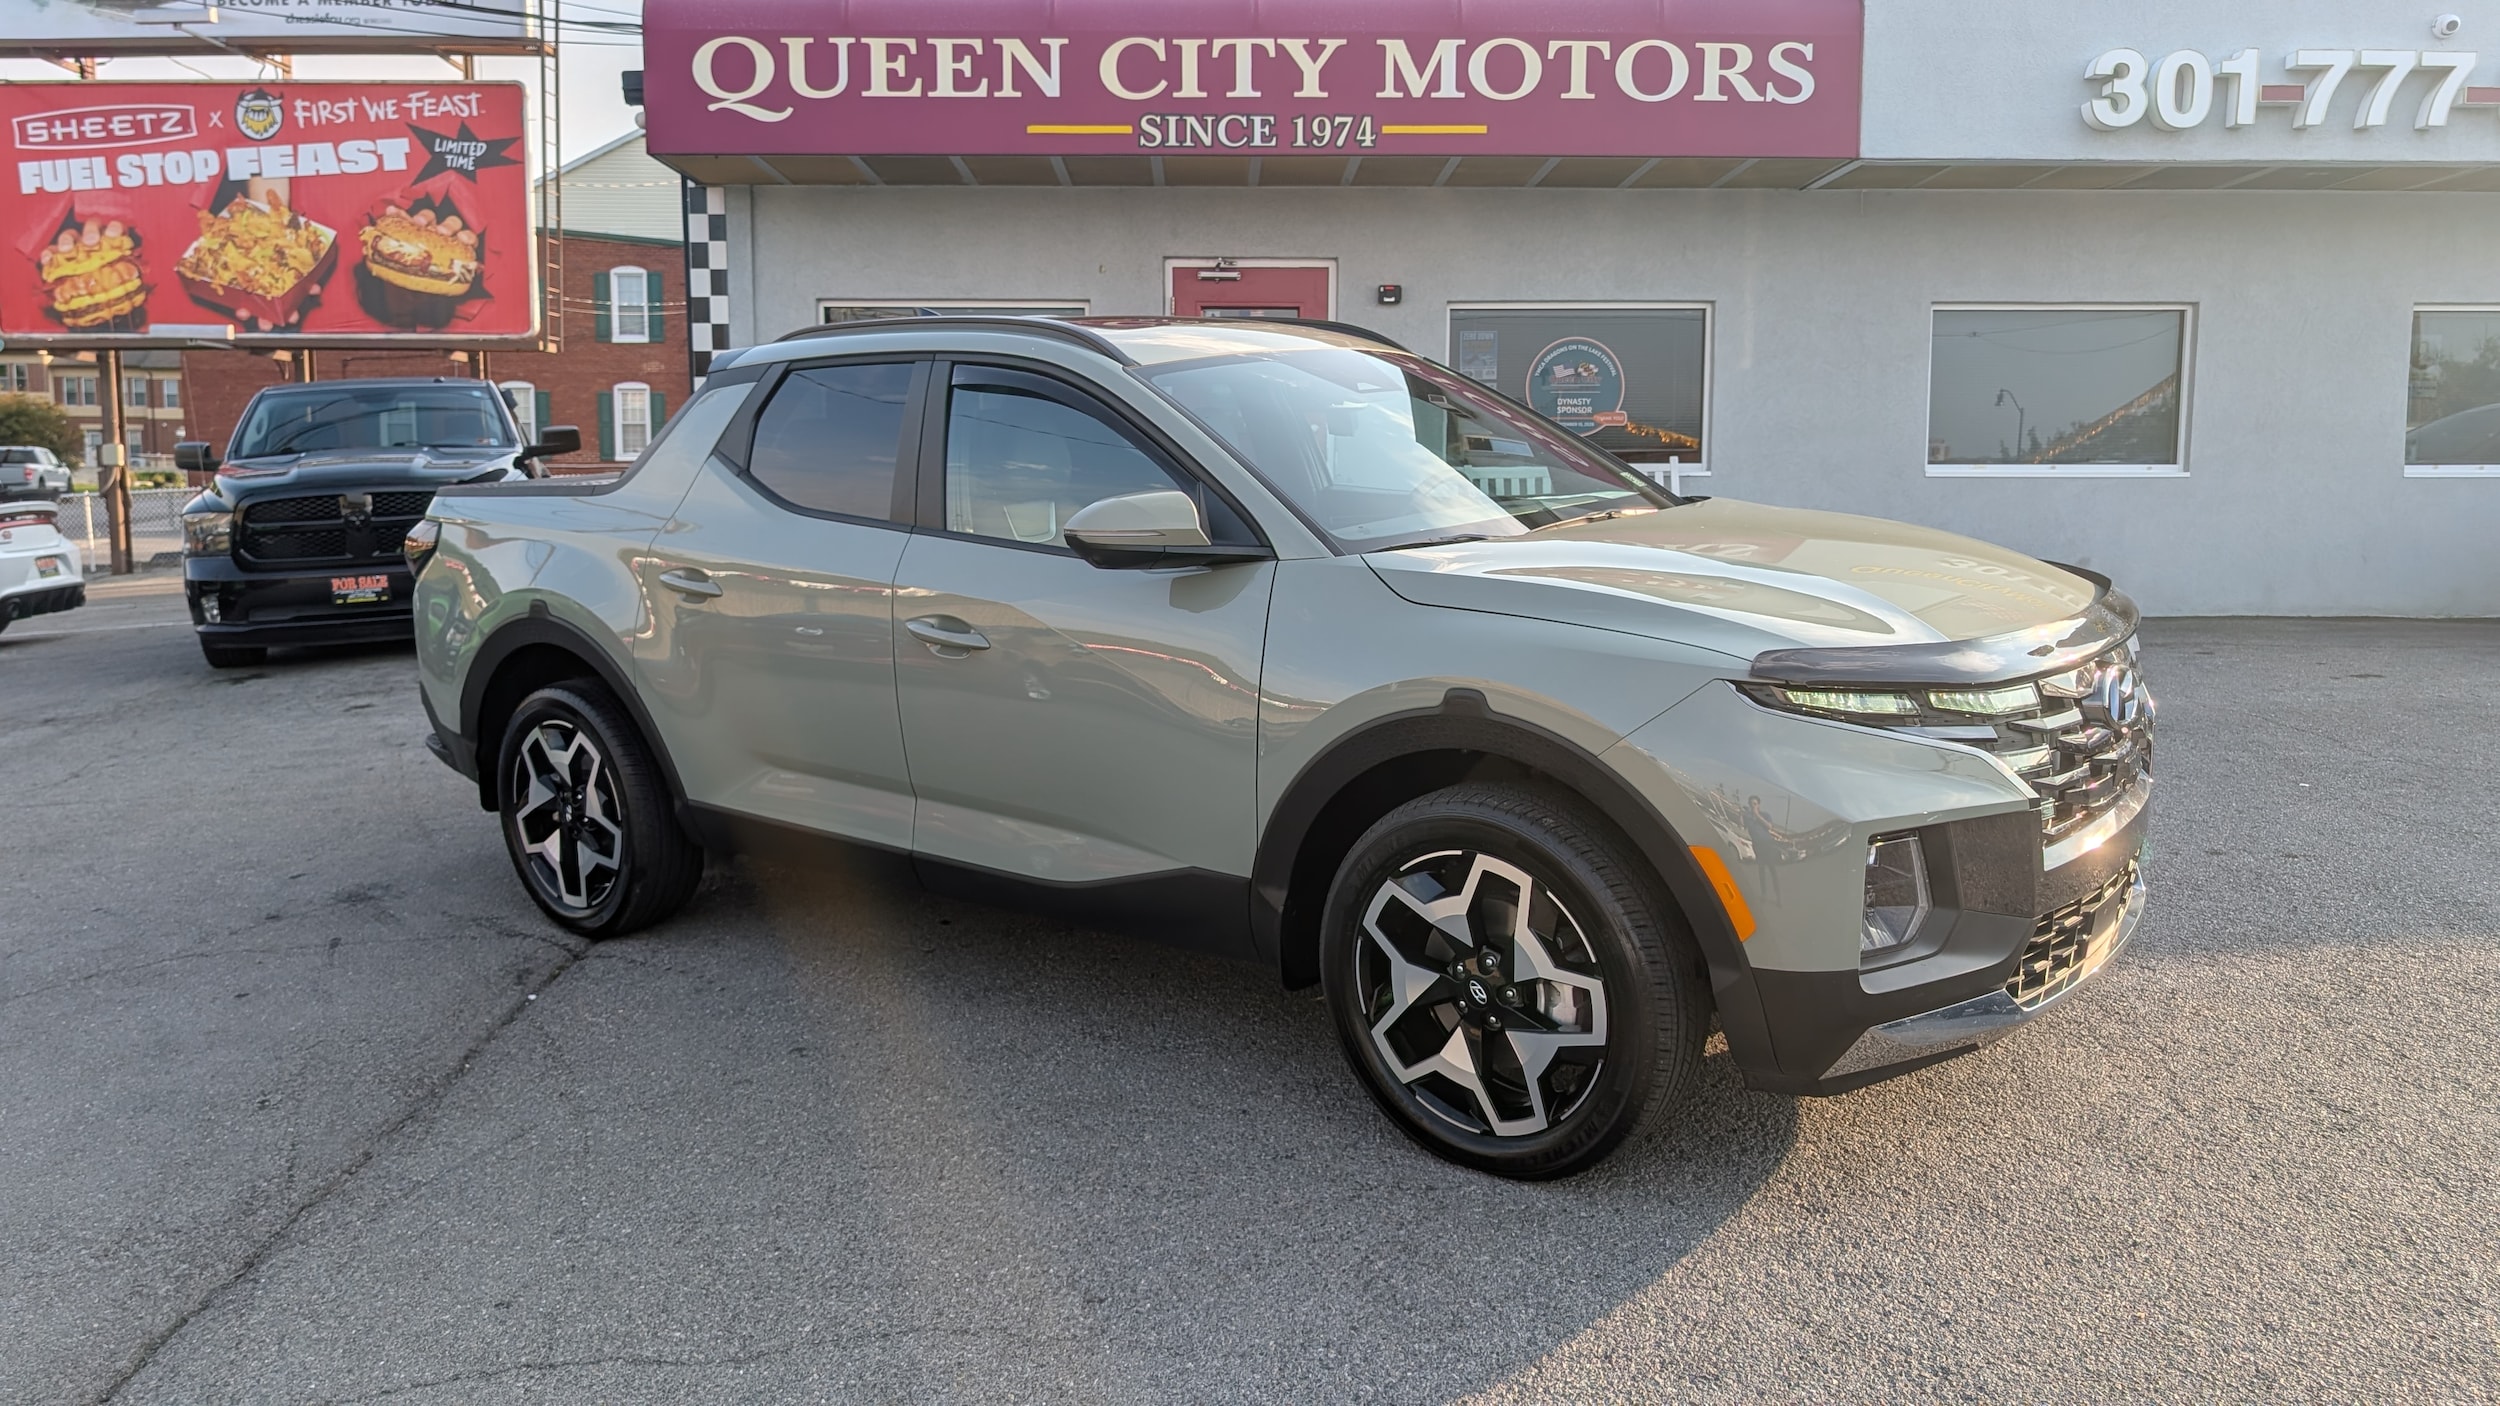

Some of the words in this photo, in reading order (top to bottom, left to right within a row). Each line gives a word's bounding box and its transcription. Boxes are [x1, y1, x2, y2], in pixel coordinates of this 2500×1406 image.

[691, 36, 1069, 122] QUEEN
[1098, 37, 1347, 100] CITY
[1376, 38, 1815, 104] MOTORS
[2081, 47, 2500, 131] 301-777-
[293, 97, 359, 128] FIRST
[361, 95, 399, 122] WE
[401, 91, 482, 120] FEAST
[26, 112, 183, 143] SHEETZ
[1138, 113, 1278, 147] SINCE
[1291, 114, 1376, 149] 1974
[434, 137, 487, 157] LIMITED
[444, 153, 476, 171] TIME
[17, 156, 113, 195] FUEL
[116, 149, 220, 188] STOP
[226, 137, 411, 181] FEAST
[1543, 345, 1568, 363] DRAGONS
[1588, 347, 1602, 357] LAKE
[1600, 354, 1617, 377] FESTIVAL
[1557, 406, 1592, 414] SPONSOR
[331, 577, 357, 592] FOR
[358, 574, 388, 589] SALE
